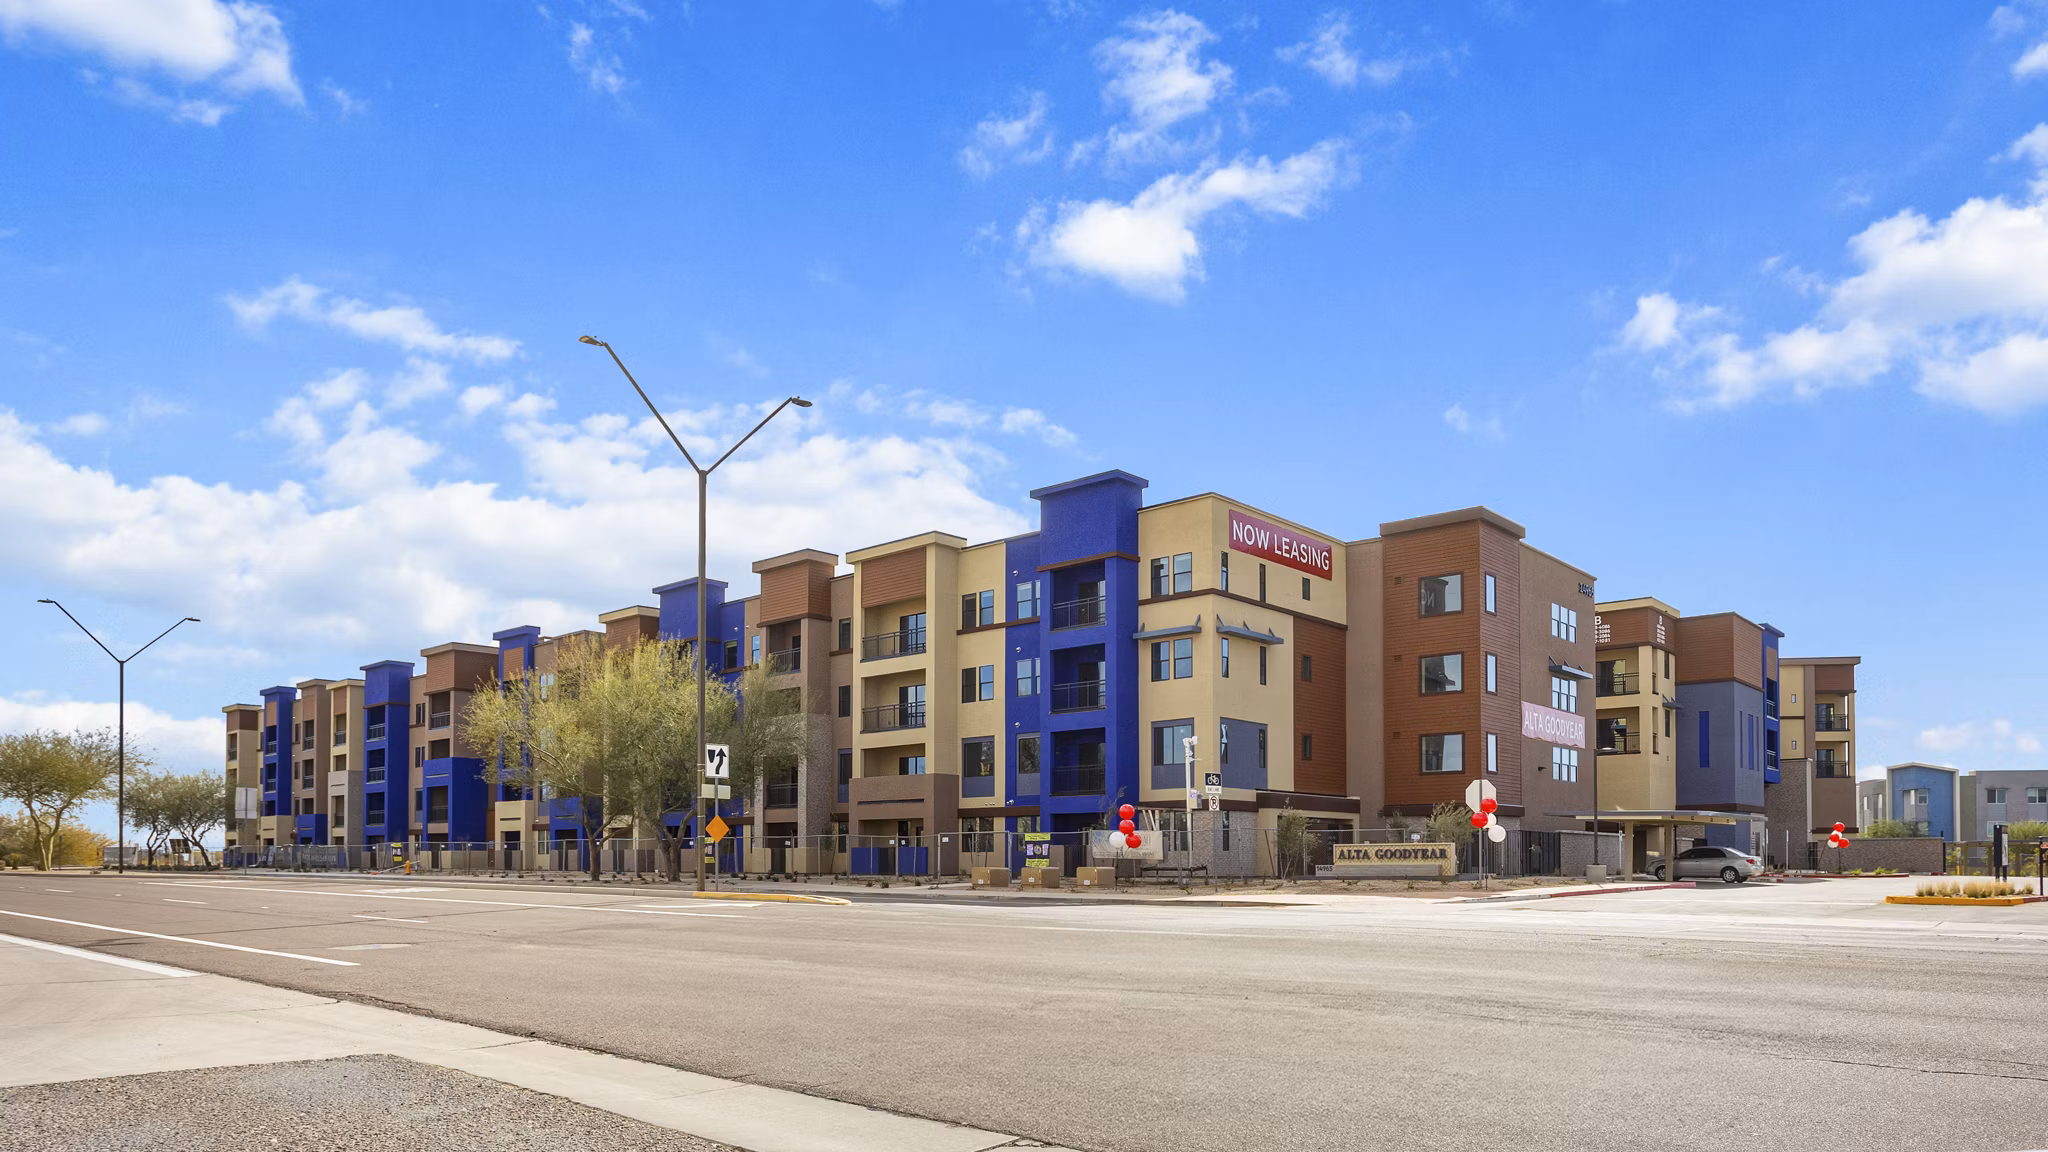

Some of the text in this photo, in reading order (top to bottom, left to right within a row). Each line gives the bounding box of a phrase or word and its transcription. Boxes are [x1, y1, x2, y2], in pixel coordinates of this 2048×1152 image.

[1233, 519, 1329, 570] NOW LEASING
[1595, 616, 1601, 625] B
[1524, 711, 1583, 739] ALTA GOODYEAR
[1338, 848, 1448, 860] ALTA GOODYEAR
